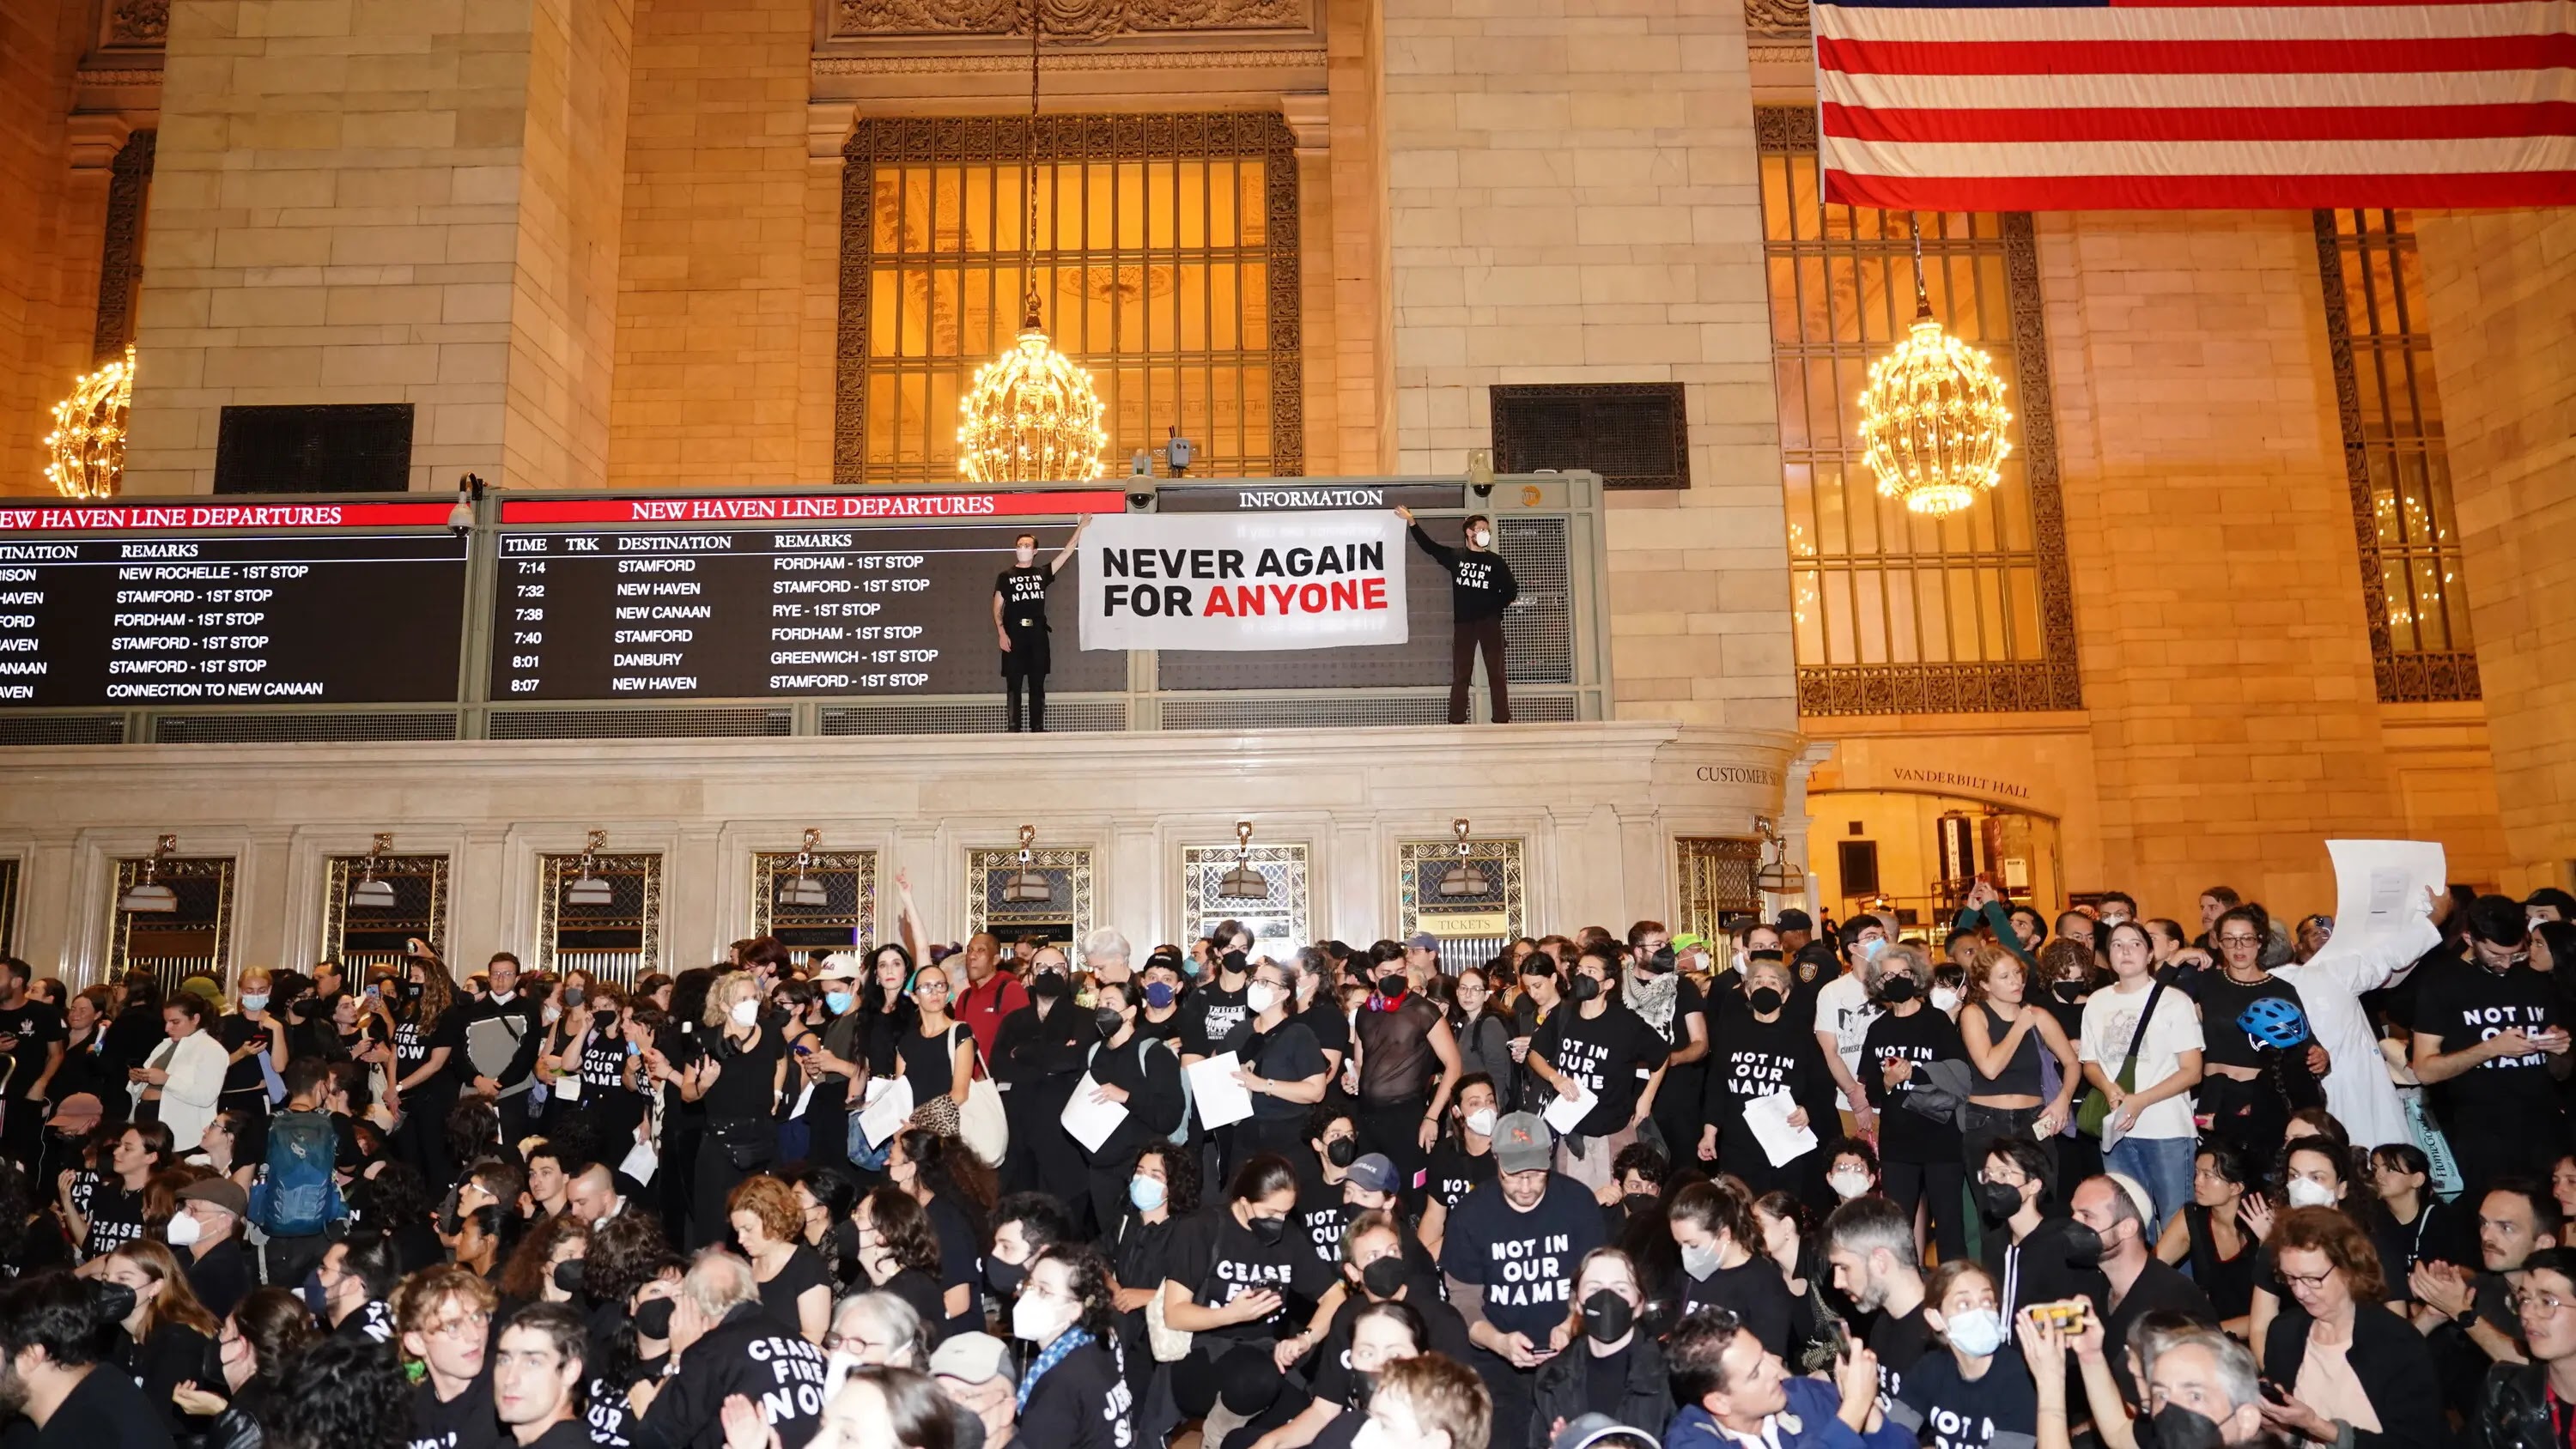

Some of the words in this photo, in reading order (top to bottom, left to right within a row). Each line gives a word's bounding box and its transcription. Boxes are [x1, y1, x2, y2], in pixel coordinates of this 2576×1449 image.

[1240, 490, 1382, 506] INFORMATION
[633, 502, 687, 518] NEW
[693, 500, 775, 518] HAVEN
[782, 500, 836, 516] LINE
[843, 497, 993, 515] DEPARTURES
[41, 510, 125, 527] HAVEN
[131, 510, 185, 525] LINE
[192, 508, 341, 525] DEPARTURES
[506, 539, 547, 551] TIME
[566, 538, 599, 550] TRK
[618, 537, 732, 549] DESTINATION
[775, 534, 852, 548] REMARKS
[121, 544, 197, 557] REMARKS
[618, 560, 696, 573] STAMFORD
[775, 557, 844, 570] FORDHAM
[857, 556, 883, 569] 1ST
[885, 556, 923, 568] STOP
[1103, 548, 1245, 579] NEVER
[1255, 542, 1384, 577] AGAIN
[1459, 561, 1477, 570] NOT
[1480, 564, 1492, 573] IN
[119, 567, 153, 579] NEW
[155, 567, 230, 579] ROCHELLE
[243, 567, 268, 579] 1ST
[270, 566, 308, 579] STOP
[519, 562, 545, 573] 7:14
[1461, 568, 1485, 579] OUR
[0, 569, 36, 581] ISON
[1009, 576, 1030, 585] NOT
[617, 584, 650, 595] NEW
[653, 583, 700, 595] HAVEN
[774, 580, 851, 593] STAMFORD
[863, 579, 889, 591] 1ST
[891, 579, 930, 591] STOP
[1016, 582, 1041, 591] OUR
[1456, 577, 1489, 590] NAME
[117, 591, 194, 603] STAMFORD
[207, 590, 232, 602] 1ST
[234, 590, 272, 602] STOP
[518, 585, 544, 597] 7:32
[1012, 591, 1044, 603] NAME
[1104, 584, 1193, 617] FOR
[1203, 578, 1388, 617] ANYONE
[516, 609, 543, 620] 7:38
[617, 607, 649, 619] NEW
[653, 606, 710, 618] CANAAN
[773, 604, 801, 616] RYE
[814, 604, 839, 616] 1ST
[842, 603, 880, 616] STOP
[114, 614, 185, 626] FORDHAM
[197, 613, 223, 626] 1ST
[226, 613, 264, 625] STOP
[514, 632, 542, 644] 7:40
[615, 630, 692, 643] STAMFORD
[772, 627, 842, 640] FORDHAM
[855, 627, 881, 640] 1ST
[884, 626, 922, 639] STOP
[0, 639, 38, 651] AVEN
[112, 637, 190, 650] STAMFORD
[203, 637, 228, 649] 1ST
[230, 636, 269, 649] STOP
[513, 656, 538, 668] 8:01
[614, 653, 683, 666] DANBURY
[771, 651, 858, 664] GREENWICH
[872, 651, 896, 663] 1ST
[900, 650, 938, 662] STOP
[109, 660, 187, 674] STAMFORD
[200, 660, 226, 672] 1ST
[228, 659, 266, 672] STOP
[512, 680, 539, 691] 8:07
[613, 678, 647, 690] NEW
[649, 677, 696, 689] HAVEN
[770, 675, 848, 688] STAMFORD
[861, 675, 887, 687] 1ST
[890, 674, 928, 686] STOP
[106, 684, 202, 697] CONNECTION
[205, 683, 225, 696] TO
[228, 683, 262, 695] NEW
[264, 682, 323, 695] CANAAN
[1697, 767, 1768, 785] CUSTOMER
[1893, 768, 1989, 790] VANDERBILT
[1992, 781, 2030, 799] HALL
[1438, 919, 1491, 931] TICKETS
[2463, 1007, 2517, 1026] NOT
[2526, 1006, 2544, 1022] IN
[2482, 1026, 2540, 1041] OR
[398, 1046, 425, 1059] OW
[1563, 1038, 1583, 1053] OT
[1588, 1044, 1609, 1060] IN
[1875, 1046, 1906, 1058] NOT
[1914, 1047, 1932, 1060] IN
[608, 1052, 623, 1061] IN
[1559, 1052, 1595, 1073] OUR
[1731, 1052, 1768, 1064] NOT
[1775, 1056, 1795, 1070] IN
[584, 1059, 614, 1073] OUR
[1735, 1064, 1783, 1082] OUR
[85, 1173, 100, 1183] IN
[72, 1185, 93, 1197] UR
[1305, 1210, 1337, 1227] NOT
[93, 1221, 142, 1239] CEASE
[94, 1237, 128, 1252] FIR
[1492, 1239, 1536, 1260] NOT
[1546, 1234, 1568, 1253] IN
[1217, 1260, 1291, 1283] CEASE
[1504, 1257, 1559, 1282] OUR
[1491, 1278, 1571, 1305] NAME
[772, 1359, 825, 1384] FIRE
[588, 1404, 623, 1434] UR
